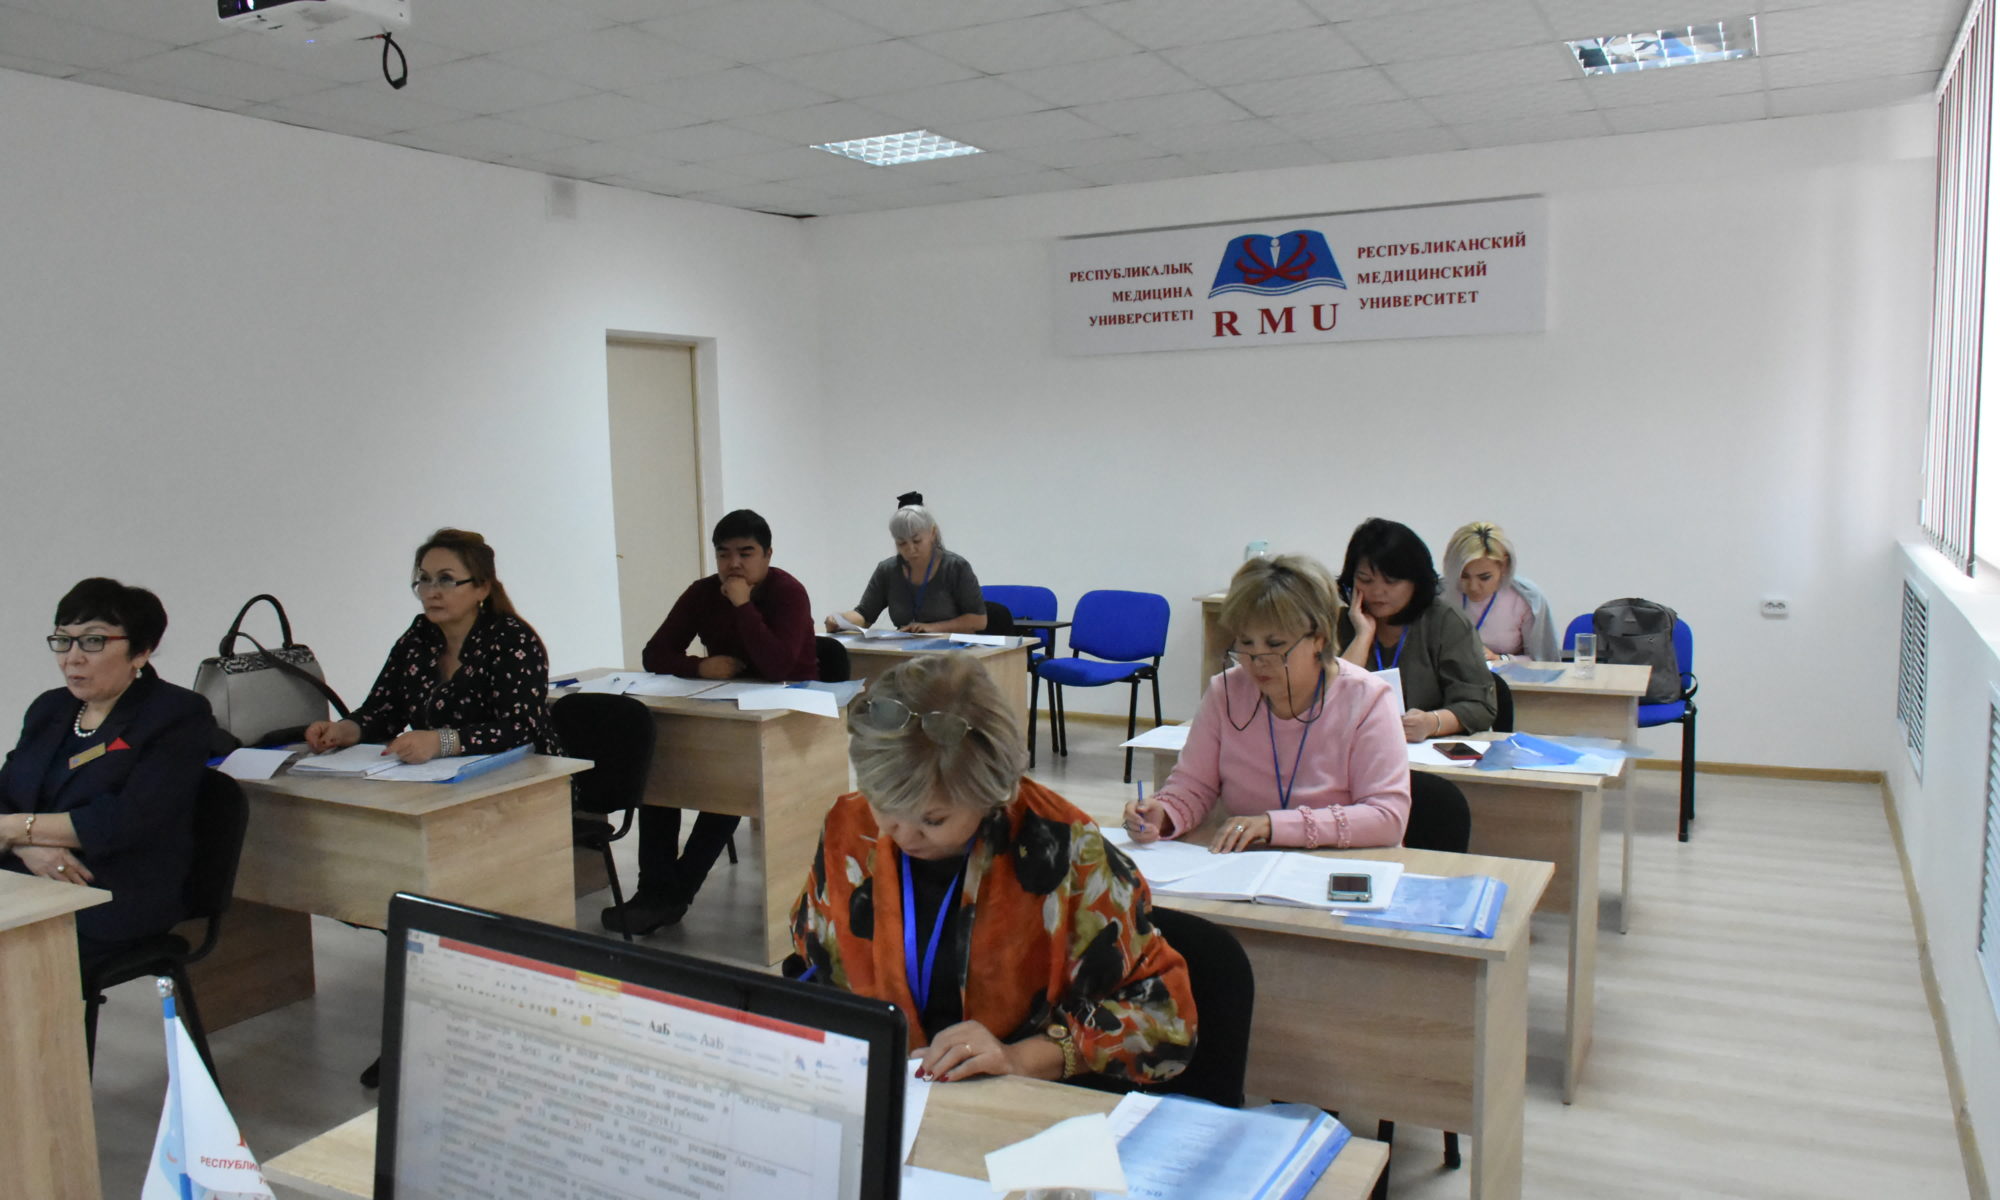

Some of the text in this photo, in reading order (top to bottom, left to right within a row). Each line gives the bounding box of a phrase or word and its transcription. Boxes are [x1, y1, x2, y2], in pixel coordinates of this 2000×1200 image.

[1357, 231, 1527, 258] РЕСПУБЛИКАНСКИЙ
[1069, 262, 1193, 283] РЕСПУБЛИКАЛЫҚ
[1357, 261, 1487, 284] МЕДИЦИНСКИЙ
[1112, 286, 1193, 302] МЕДИЦИНА
[1359, 290, 1478, 309] УНИВЕРСИТЕТ
[1089, 310, 1193, 327] УНИВЕРСИТЕТІ
